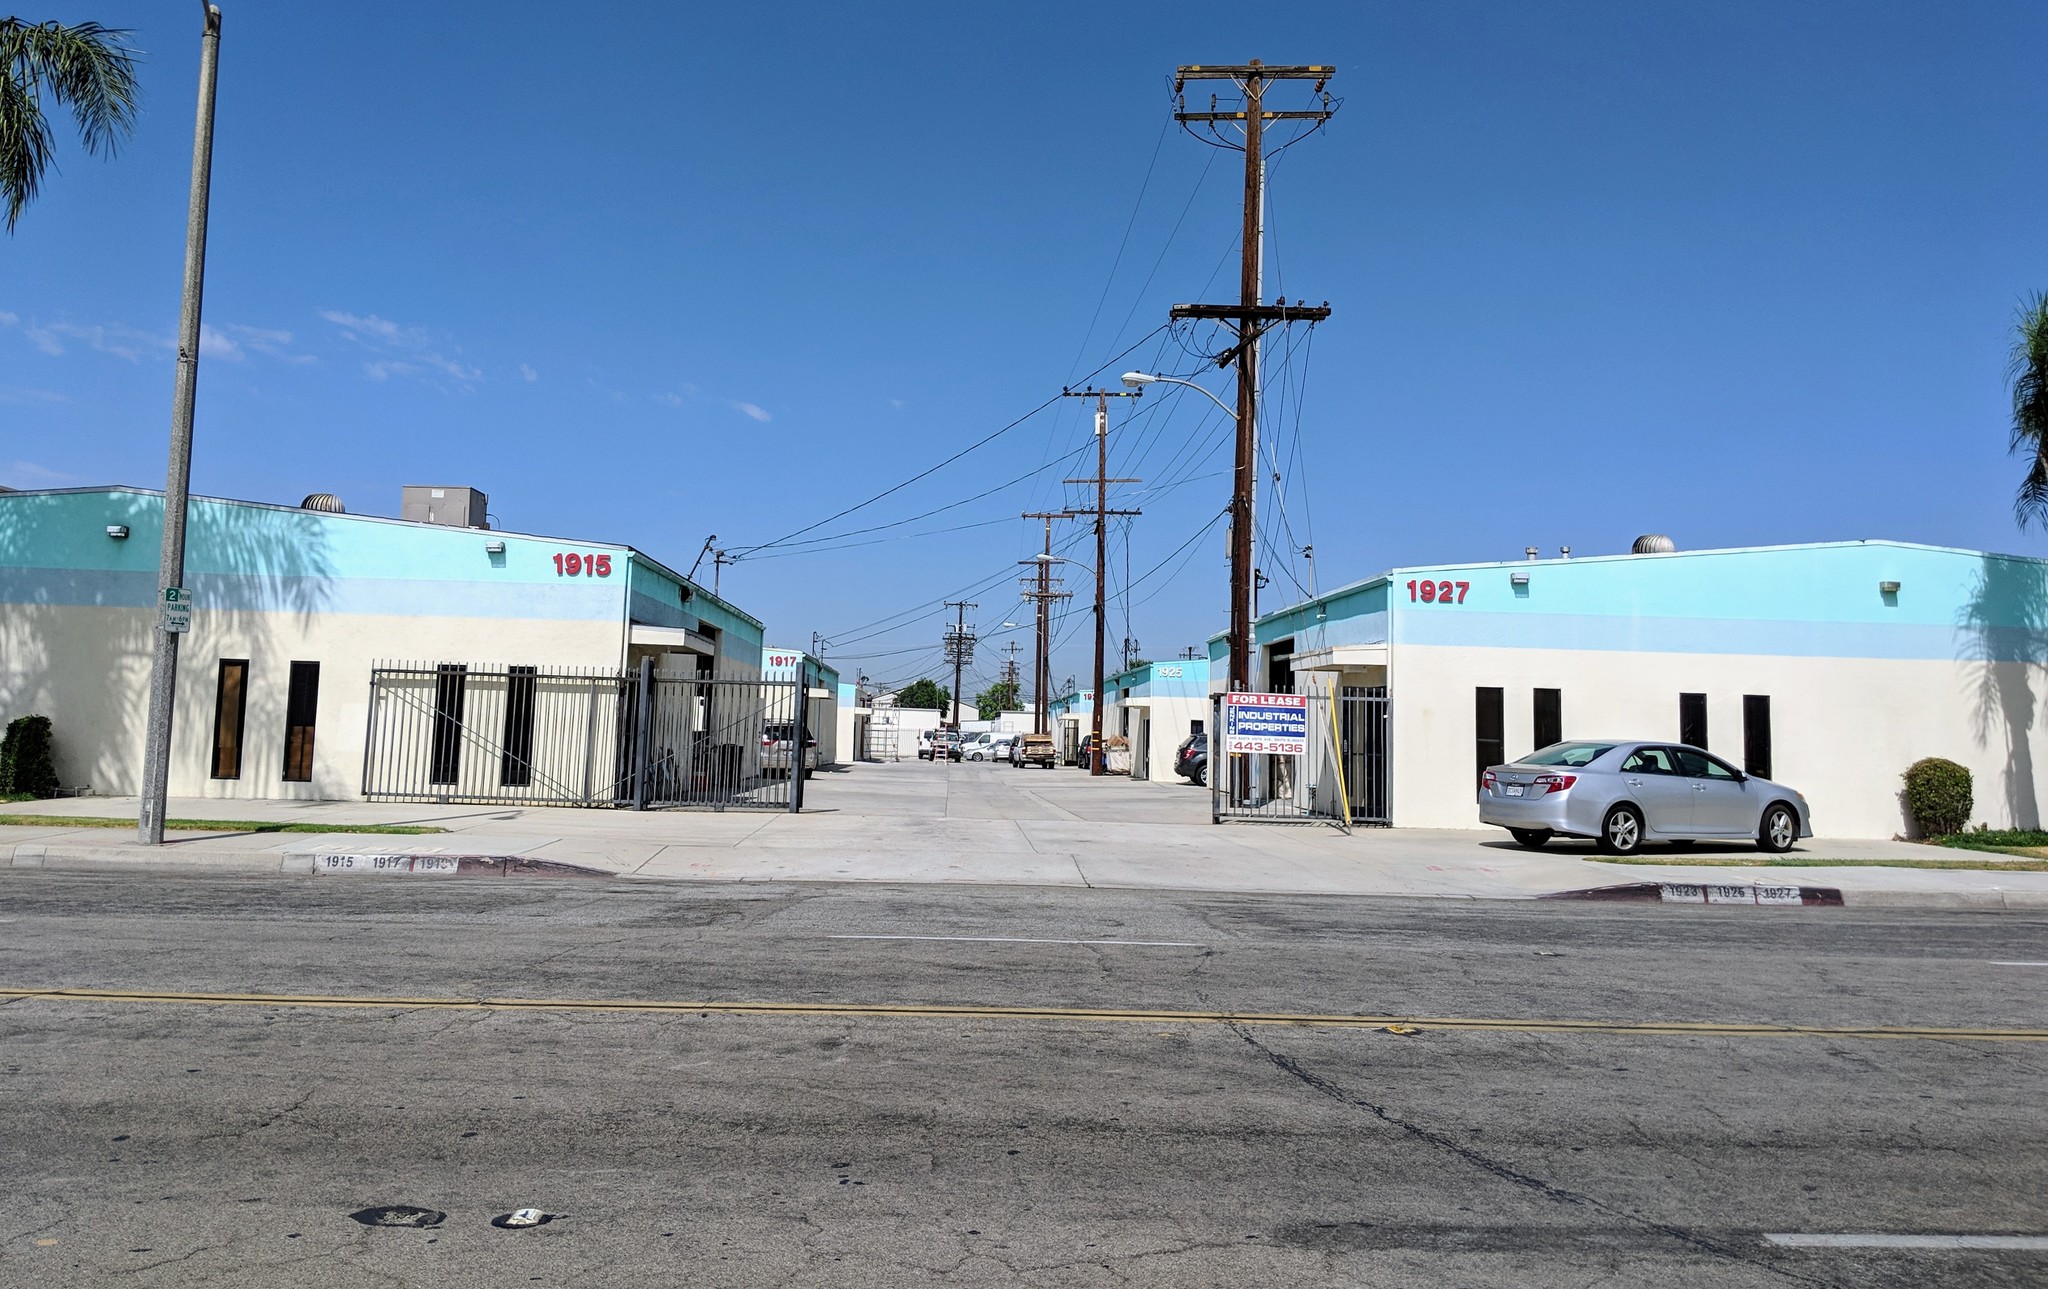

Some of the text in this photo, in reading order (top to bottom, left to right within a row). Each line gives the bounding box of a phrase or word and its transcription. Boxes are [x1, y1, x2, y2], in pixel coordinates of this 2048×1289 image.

[553, 553, 611, 577] 1915
[170, 590, 176, 600] 2
[1407, 580, 1470, 604] 1927
[167, 603, 190, 612] PARKING
[769, 656, 797, 667] 1917
[1158, 667, 1182, 678] 1925
[1232, 695, 1301, 706] FOR LEASE
[1238, 711, 1304, 721] INDUSTRIAL
[1238, 722, 1305, 732] PROPERTIES
[1233, 741, 1303, 753] 443-5136
[326, 855, 354, 868] 1915
[373, 856, 402, 869] 1917
[1763, 887, 1792, 899] 1927
